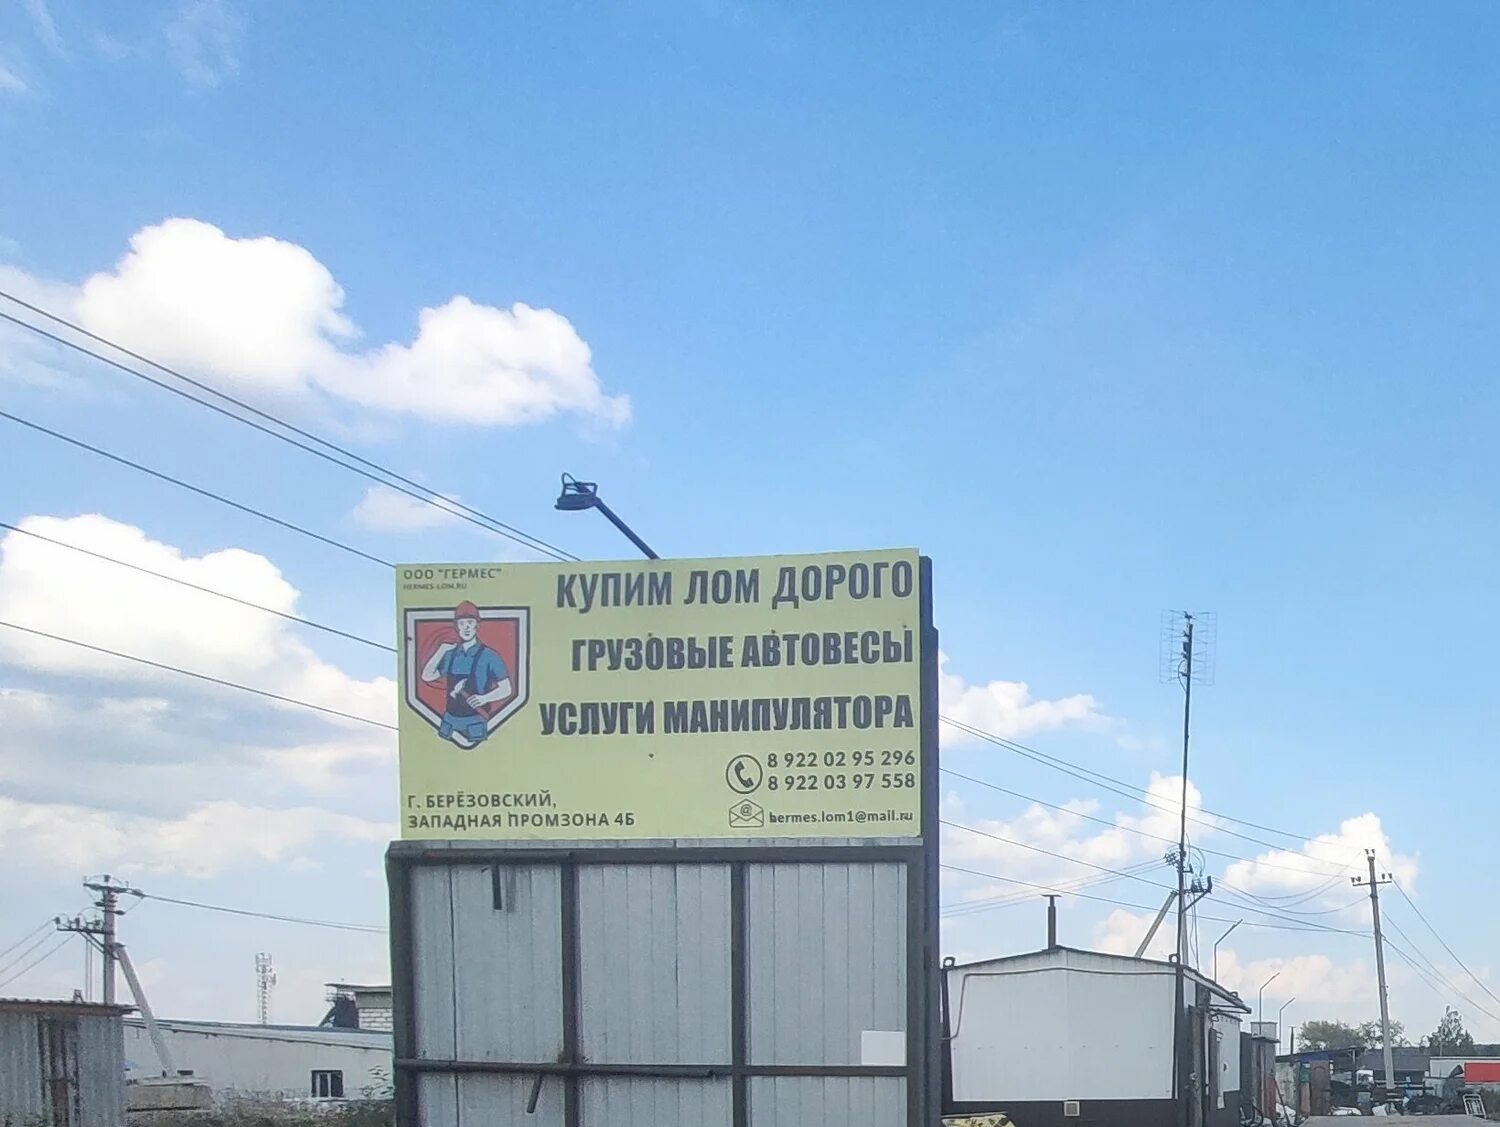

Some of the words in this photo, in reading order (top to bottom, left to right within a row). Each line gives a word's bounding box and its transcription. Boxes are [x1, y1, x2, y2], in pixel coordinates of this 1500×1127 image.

[403, 569, 434, 580] ООО
[556, 569, 672, 614] КУПИМ
[684, 567, 760, 606] ЛОМ
[772, 560, 913, 610] ДОРОГО
[571, 636, 733, 672] ГРУЗОВЫЕ
[740, 630, 913, 669] АВТОВЕСЫ
[539, 701, 654, 736] УСЛУГИ
[664, 695, 914, 734] МАНИПУЛЯТОРА
[767, 753, 778, 768] 8
[784, 752, 818, 768] 922
[824, 751, 846, 767] 02
[852, 751, 874, 766] 95
[881, 750, 915, 766] 296
[767, 776, 778, 790] 8
[784, 775, 818, 790] 922
[824, 774, 846, 790] 03
[852, 774, 875, 789] 97
[881, 773, 915, 788] 558
[426, 789, 557, 808] БЕРЁЗОВСКИЙ,
[408, 814, 501, 831] ЗАПАДНАЯ
[508, 812, 609, 828] ПРОМЗОНА
[614, 812, 635, 826] 4Б
